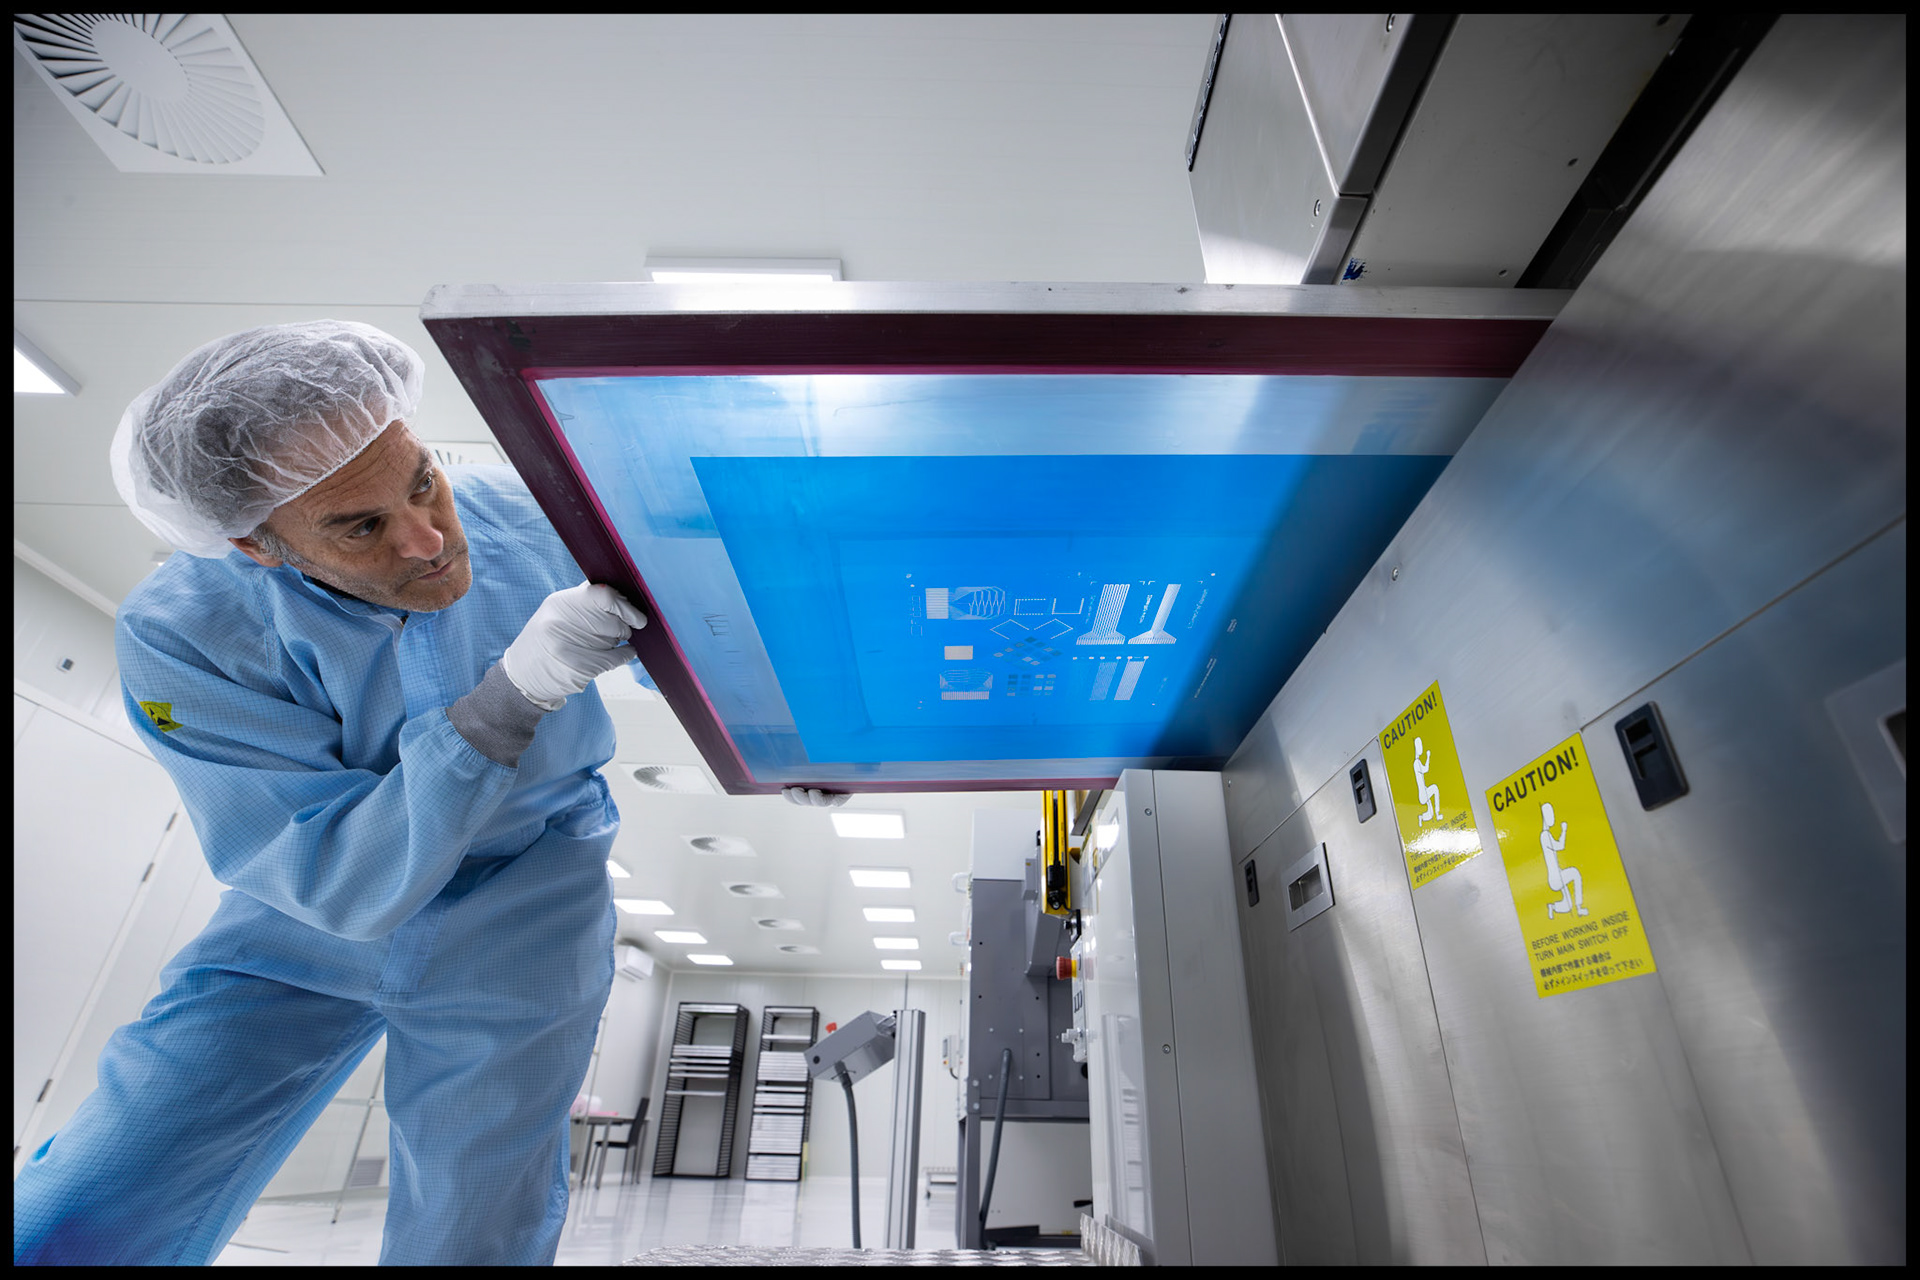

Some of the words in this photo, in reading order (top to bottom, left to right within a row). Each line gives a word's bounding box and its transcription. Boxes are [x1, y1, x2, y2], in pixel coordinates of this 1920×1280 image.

[1383, 691, 1437, 749] CAUTION!
[1493, 746, 1579, 812] CAUTION!
[1531, 933, 1560, 950] BEFORE
[1561, 920, 1598, 940] WORKING
[1601, 910, 1630, 928] INSIDE
[1535, 949, 1555, 962] TURN
[1556, 942, 1576, 956] MAIN
[1578, 932, 1610, 950] SWITCH
[1612, 925, 1629, 940] OFF
